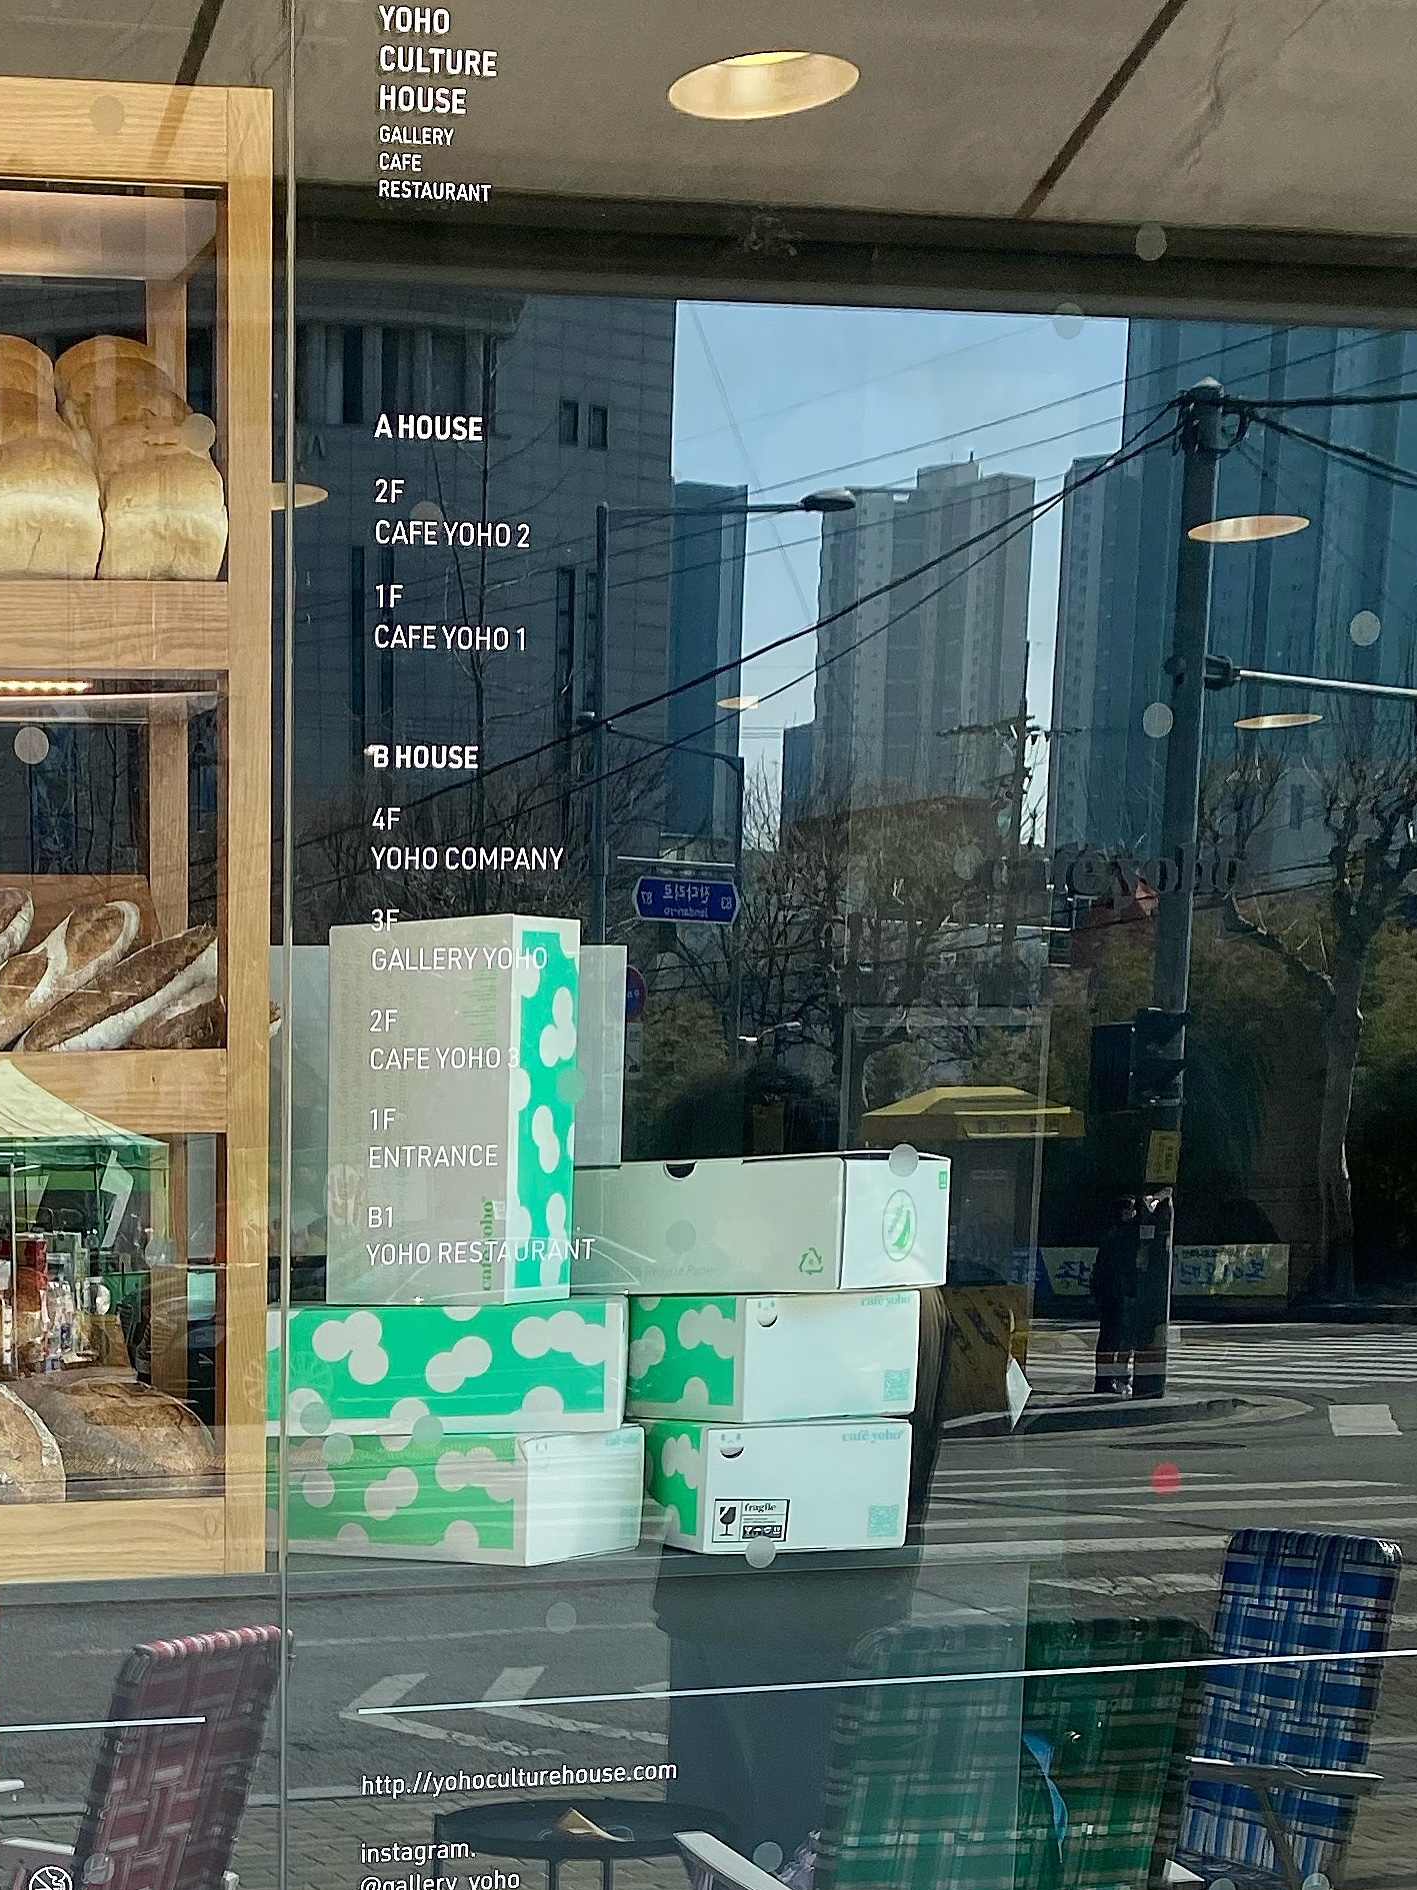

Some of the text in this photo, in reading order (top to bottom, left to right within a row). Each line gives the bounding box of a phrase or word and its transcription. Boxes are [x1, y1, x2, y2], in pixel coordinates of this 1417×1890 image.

[379, 6, 451, 36] YOHO
[379, 45, 498, 77] CULTURE
[379, 86, 467, 116] HOUSE
[379, 126, 454, 147] GALLERY
[379, 152, 422, 172] CAFE
[378, 180, 491, 203] RESTAURANT
[375, 413, 484, 442] A HOUSE
[375, 478, 405, 505] 2F
[375, 520, 531, 549] CAFE YOHO 2
[375, 584, 403, 609] 1F
[375, 624, 527, 652] CAFE YOHO 1
[395, 745, 479, 770] HOUSE
[371, 807, 401, 831] 4F
[371, 846, 564, 872] YOHO COMPANY
[371, 908, 399, 932] 3F
[371, 946, 478, 972] GALLERY
[481, 946, 548, 972] YOHO
[370, 1008, 398, 1032] 2F
[369, 1046, 521, 1071] CAFE YOHO 3
[369, 1107, 396, 1131] 1F
[369, 1144, 499, 1170] ENTRANCE
[368, 1205, 394, 1229] B1
[366, 1238, 596, 1266] YOHO RESTAURANT
[359, 1840, 476, 1867] instagram.
